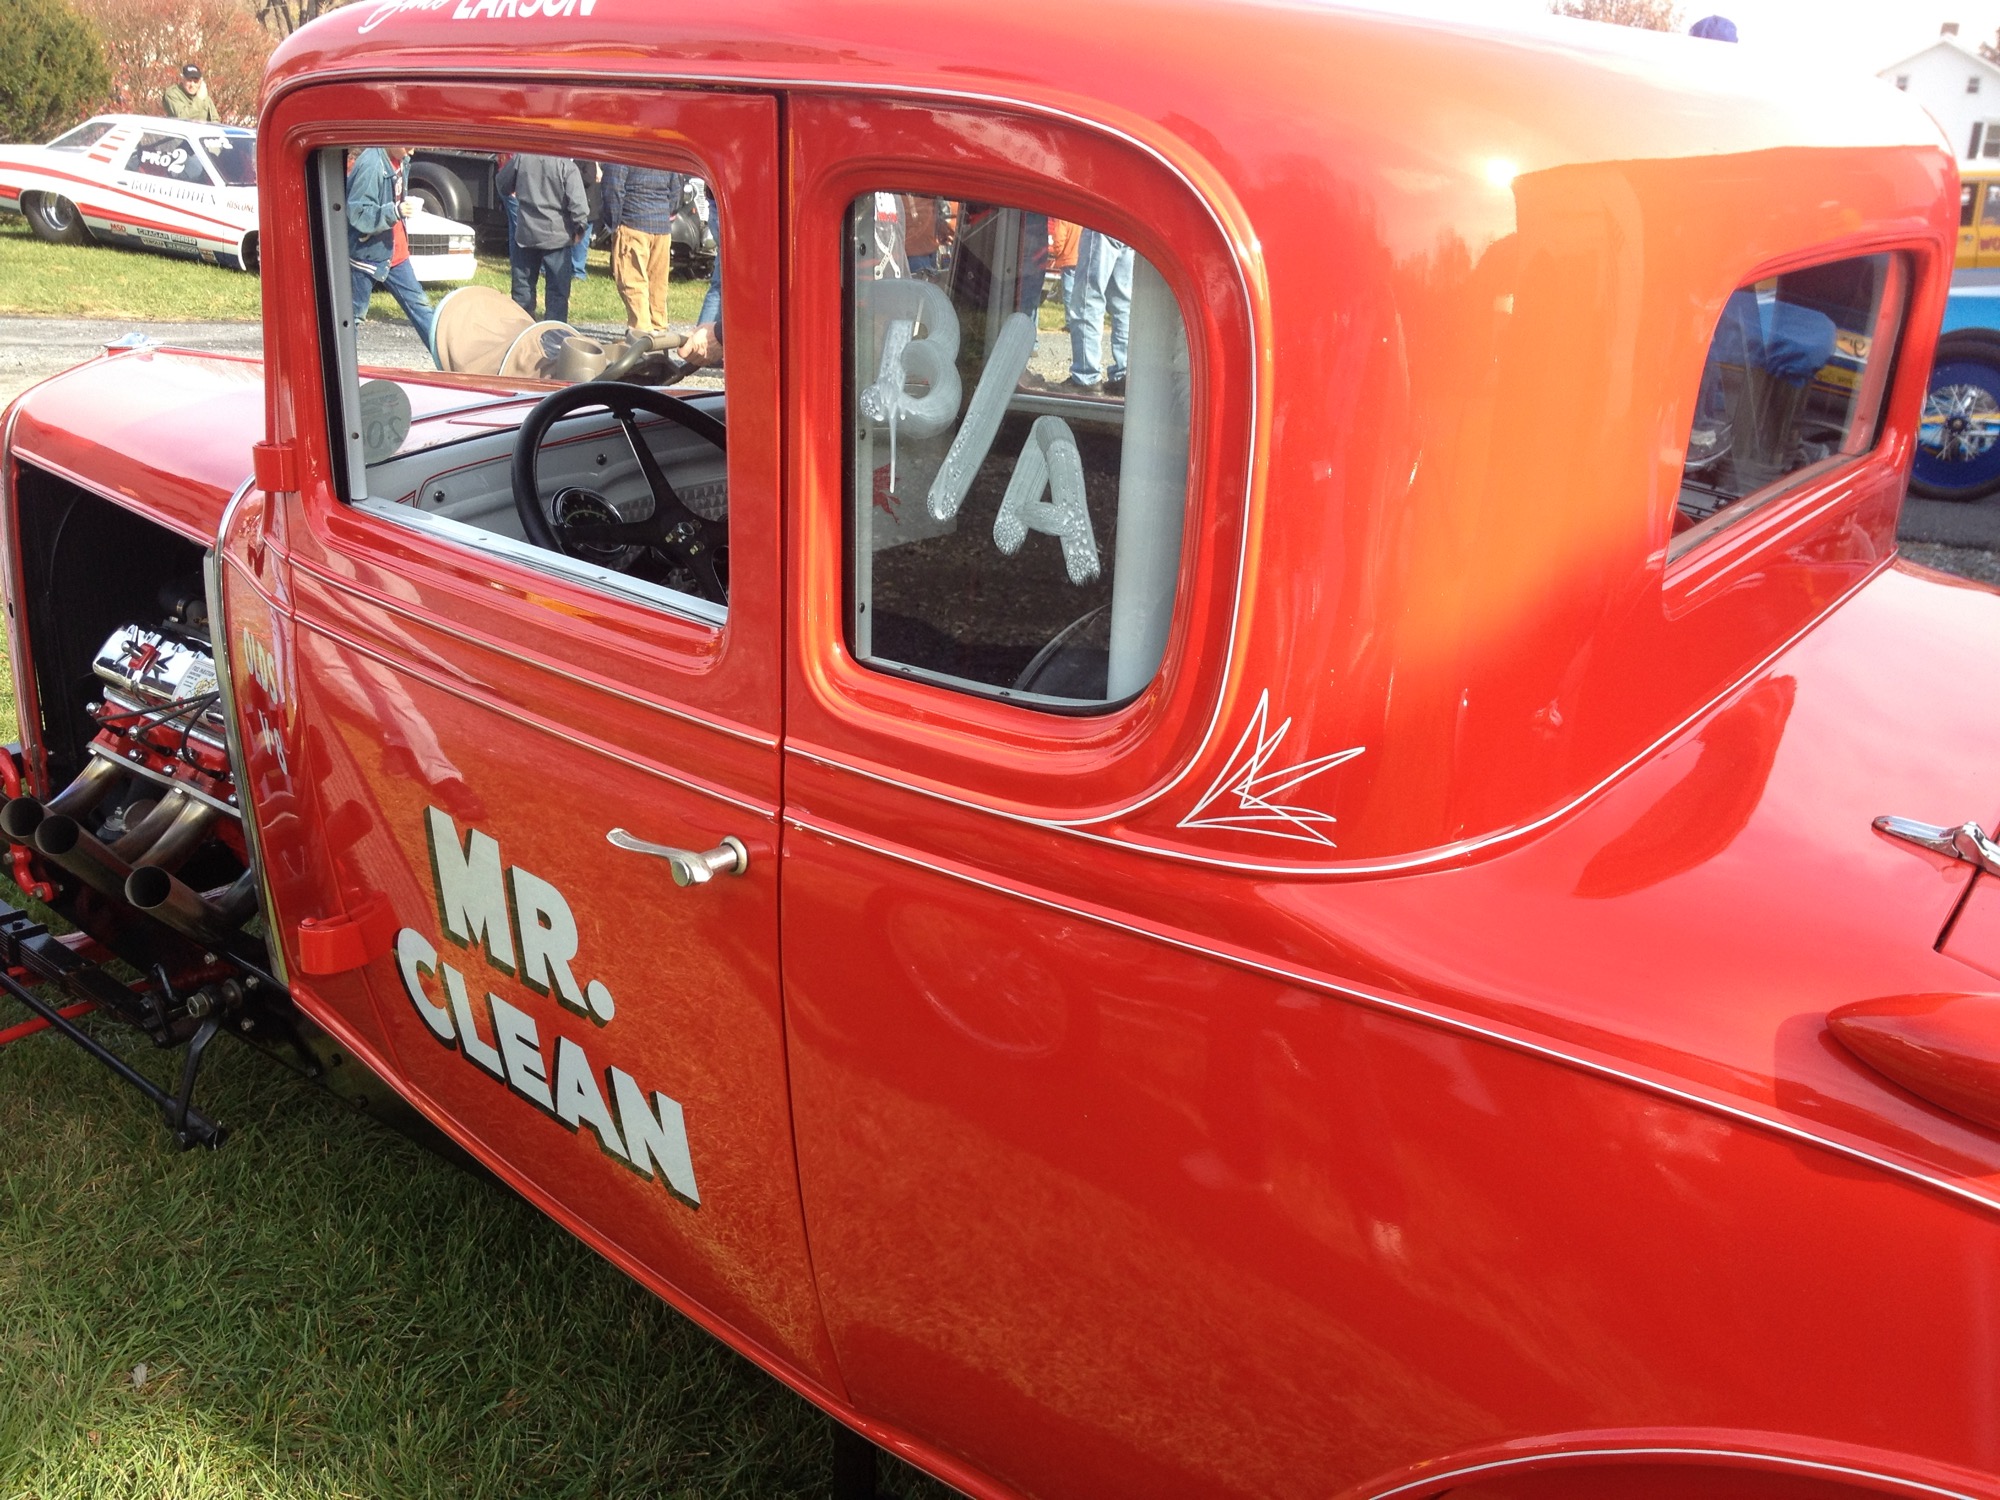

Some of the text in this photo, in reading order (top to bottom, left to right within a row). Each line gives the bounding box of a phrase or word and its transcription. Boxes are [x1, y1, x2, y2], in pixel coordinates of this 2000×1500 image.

[243, 626, 278, 705] OLDS
[424, 804, 615, 1028] MR.
[394, 927, 701, 1211] CLEAN
